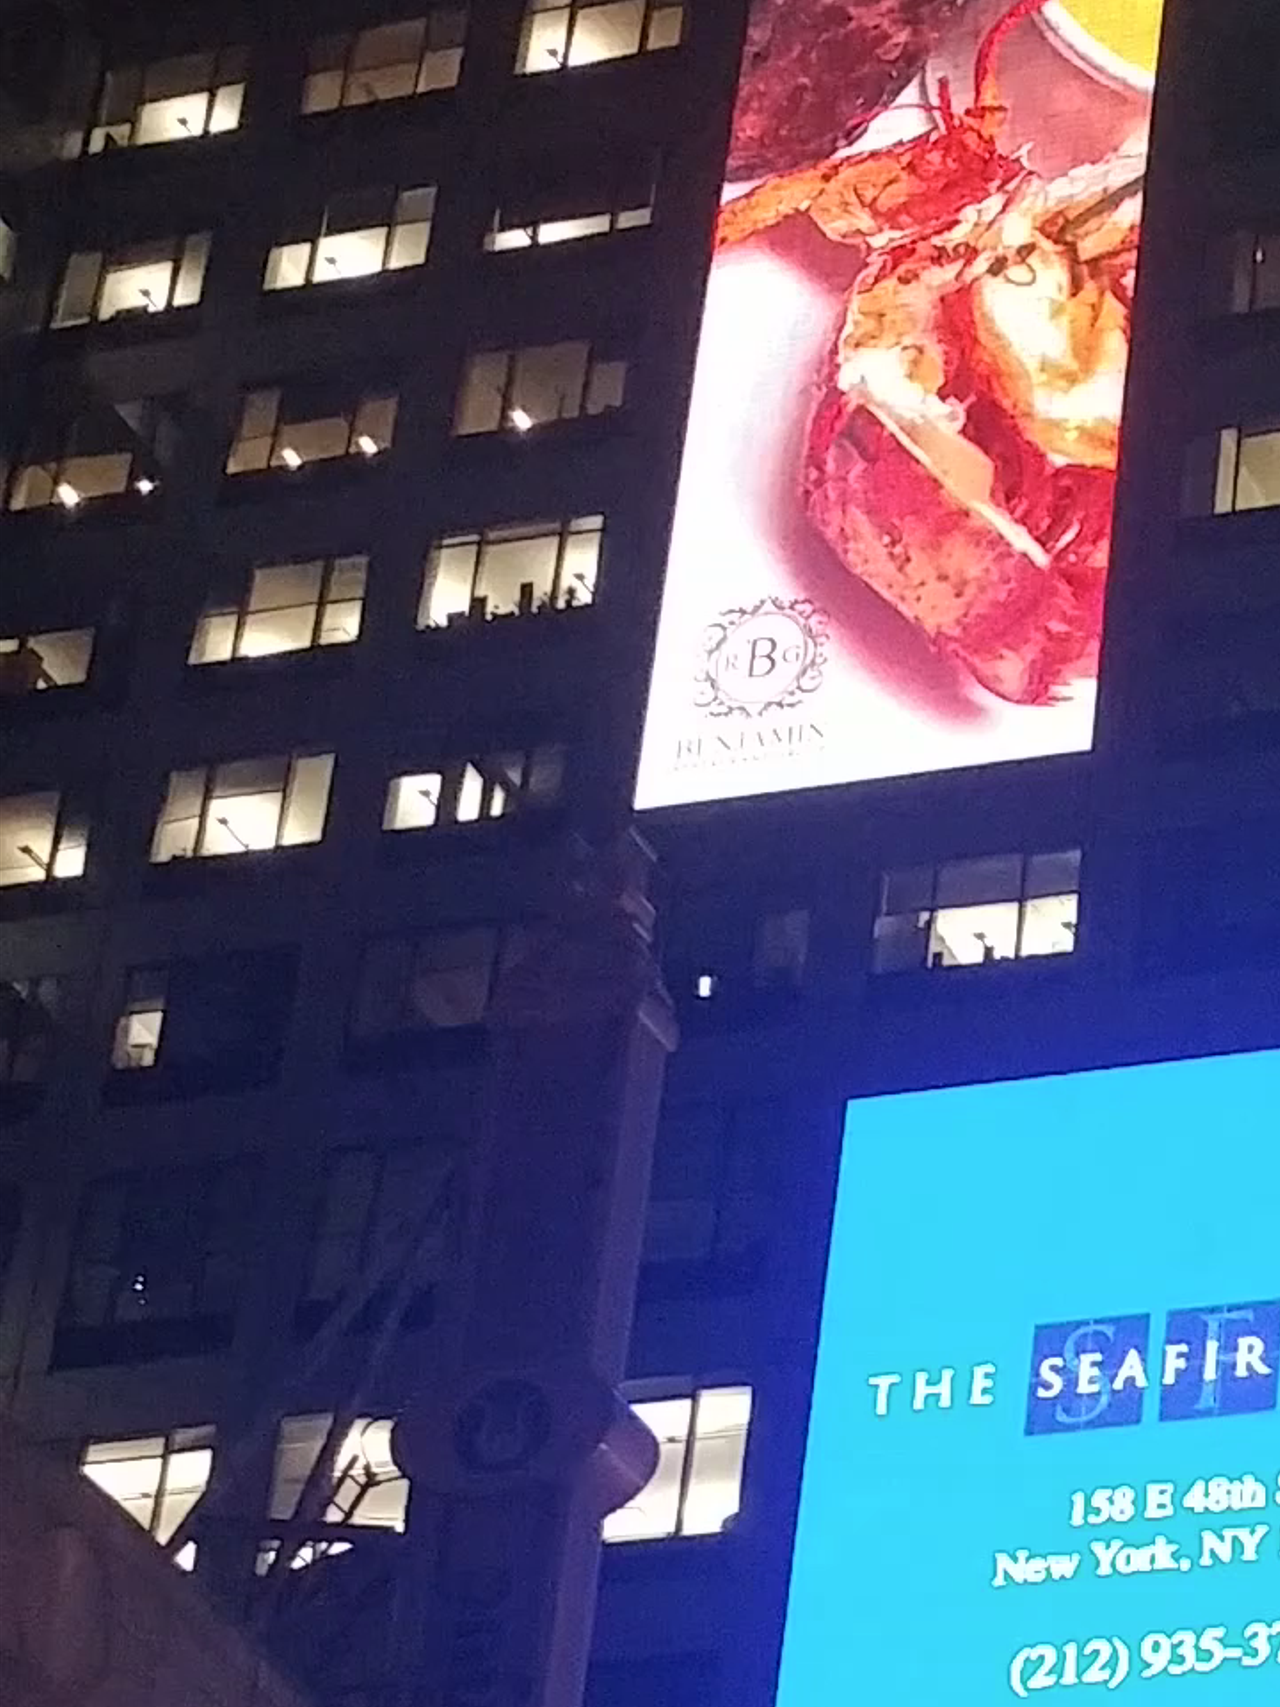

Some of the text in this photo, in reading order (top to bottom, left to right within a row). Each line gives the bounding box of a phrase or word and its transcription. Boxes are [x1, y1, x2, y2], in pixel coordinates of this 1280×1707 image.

[748, 636, 778, 678] B
[868, 1363, 998, 1416] THE
[1068, 1484, 1135, 1527] 158
[1145, 1481, 1174, 1519] E
[1182, 1473, 1267, 1515] 48th
[990, 1548, 1080, 1588] New
[1090, 1535, 1192, 1576] York,
[1200, 1524, 1267, 1569] NY
[1009, 1635, 1130, 1697] (212)
